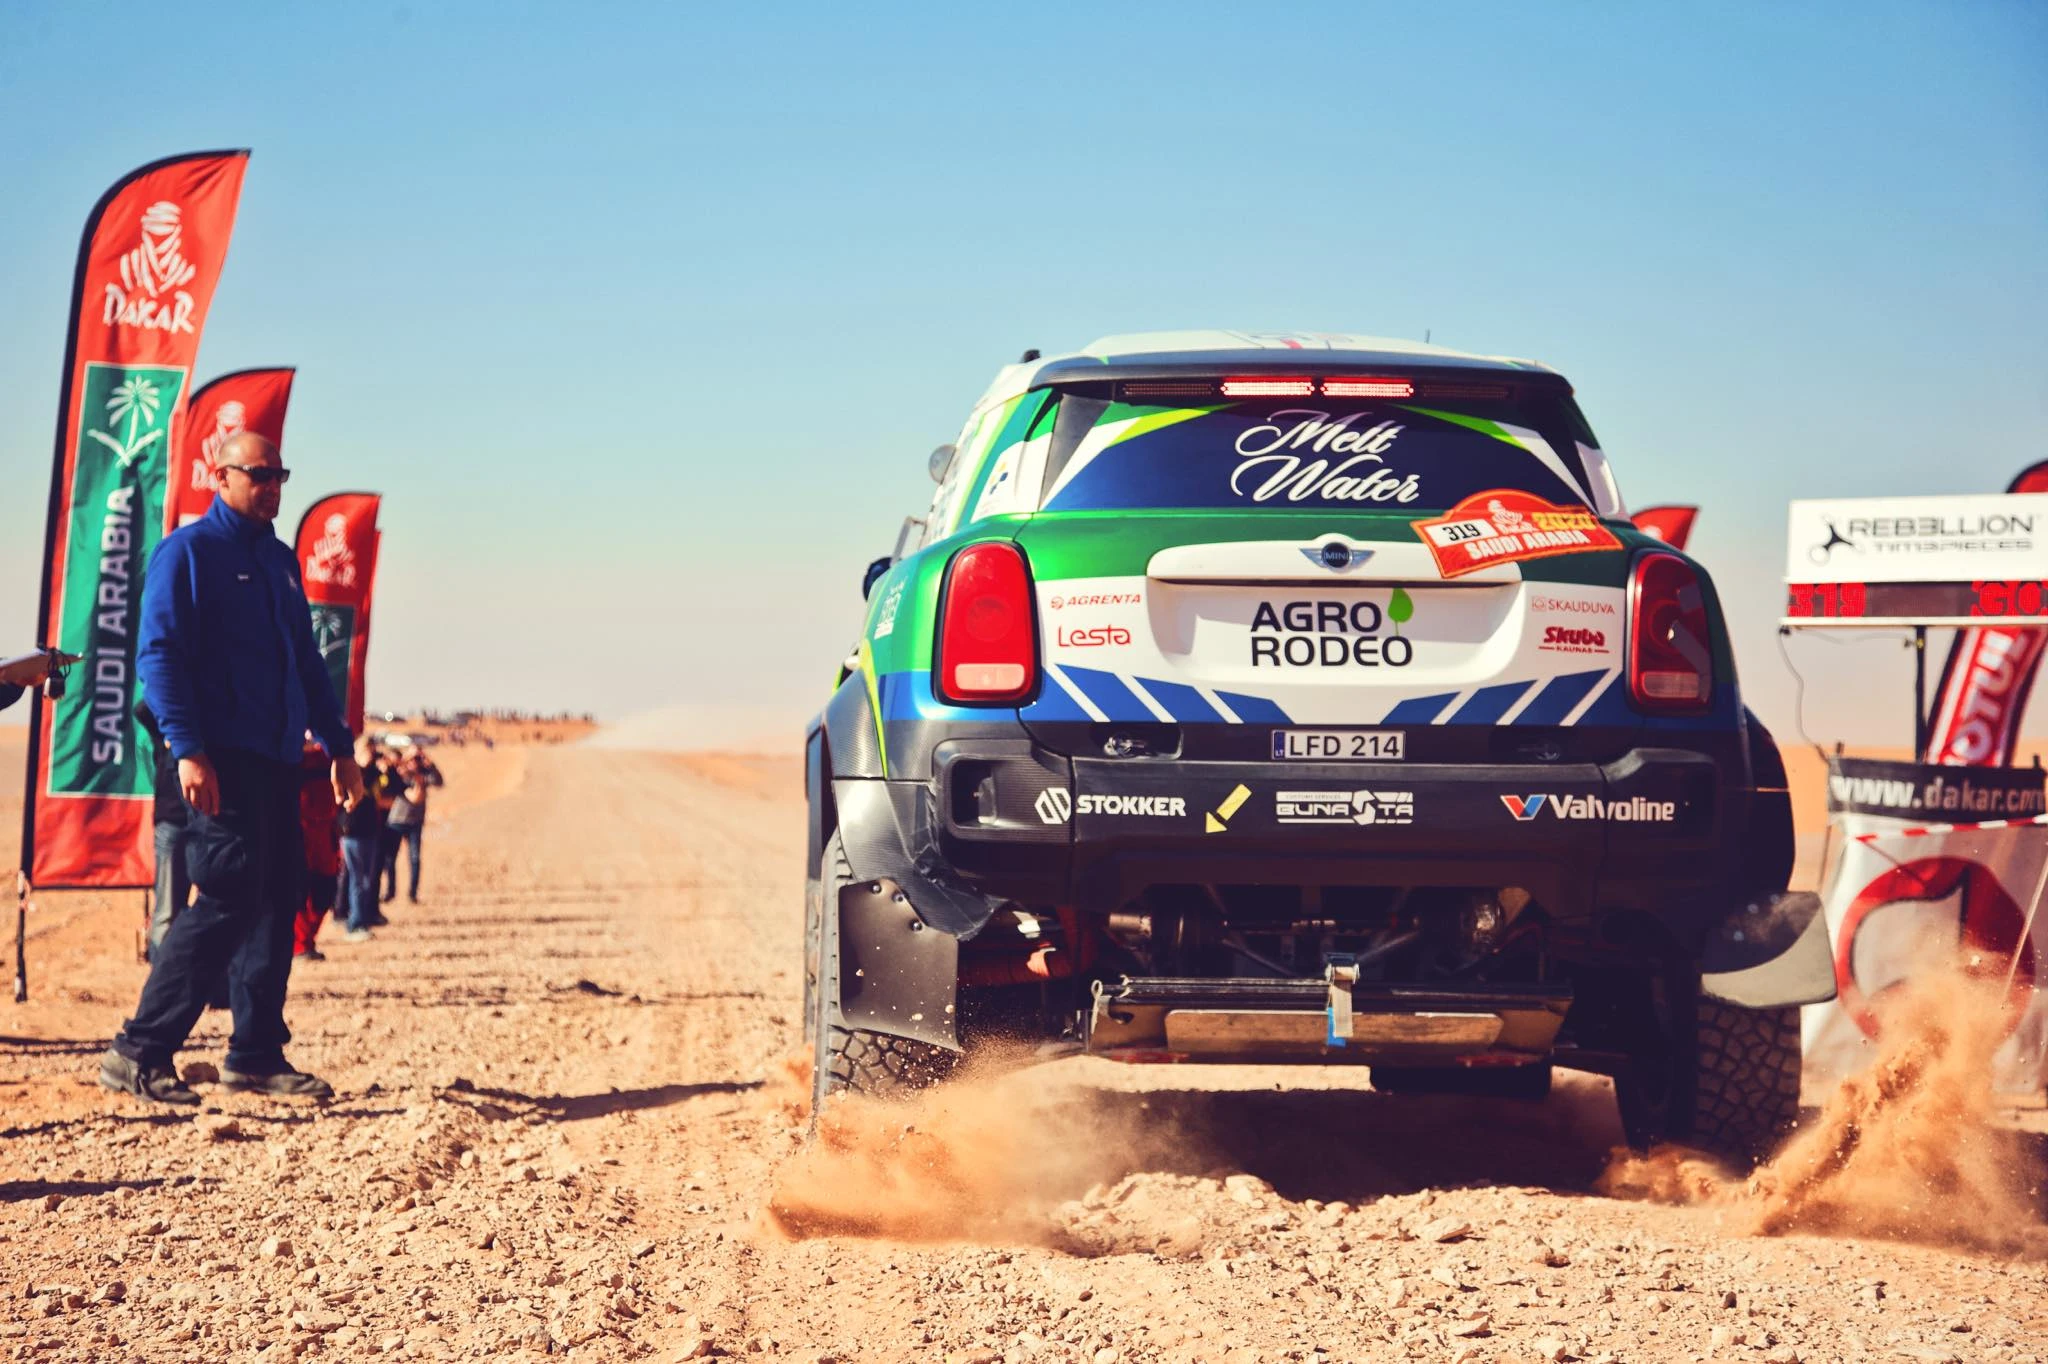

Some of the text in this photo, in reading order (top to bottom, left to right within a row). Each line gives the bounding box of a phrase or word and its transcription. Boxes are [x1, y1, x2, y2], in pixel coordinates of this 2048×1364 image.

[103, 283, 195, 334] DAKAR
[1235, 409, 1406, 456] Melt
[1231, 454, 1420, 503] Water
[1442, 523, 1481, 541] 319
[1849, 514, 2034, 537] REBELLION
[1464, 530, 1592, 560] SAUDI ARABIA
[1066, 593, 1141, 605] AGRENTA
[1548, 599, 1615, 615] SKAUDUVA
[1788, 583, 1867, 617] 319
[92, 485, 135, 766] SAUDI ARABIA
[1251, 601, 1382, 632] AGRO
[1058, 624, 1131, 647] Lesta
[1251, 636, 1413, 667] RODEO
[1290, 735, 1400, 756] LFD 214
[1076, 795, 1186, 816] STOKKER
[1549, 795, 1675, 821] Valvoline
